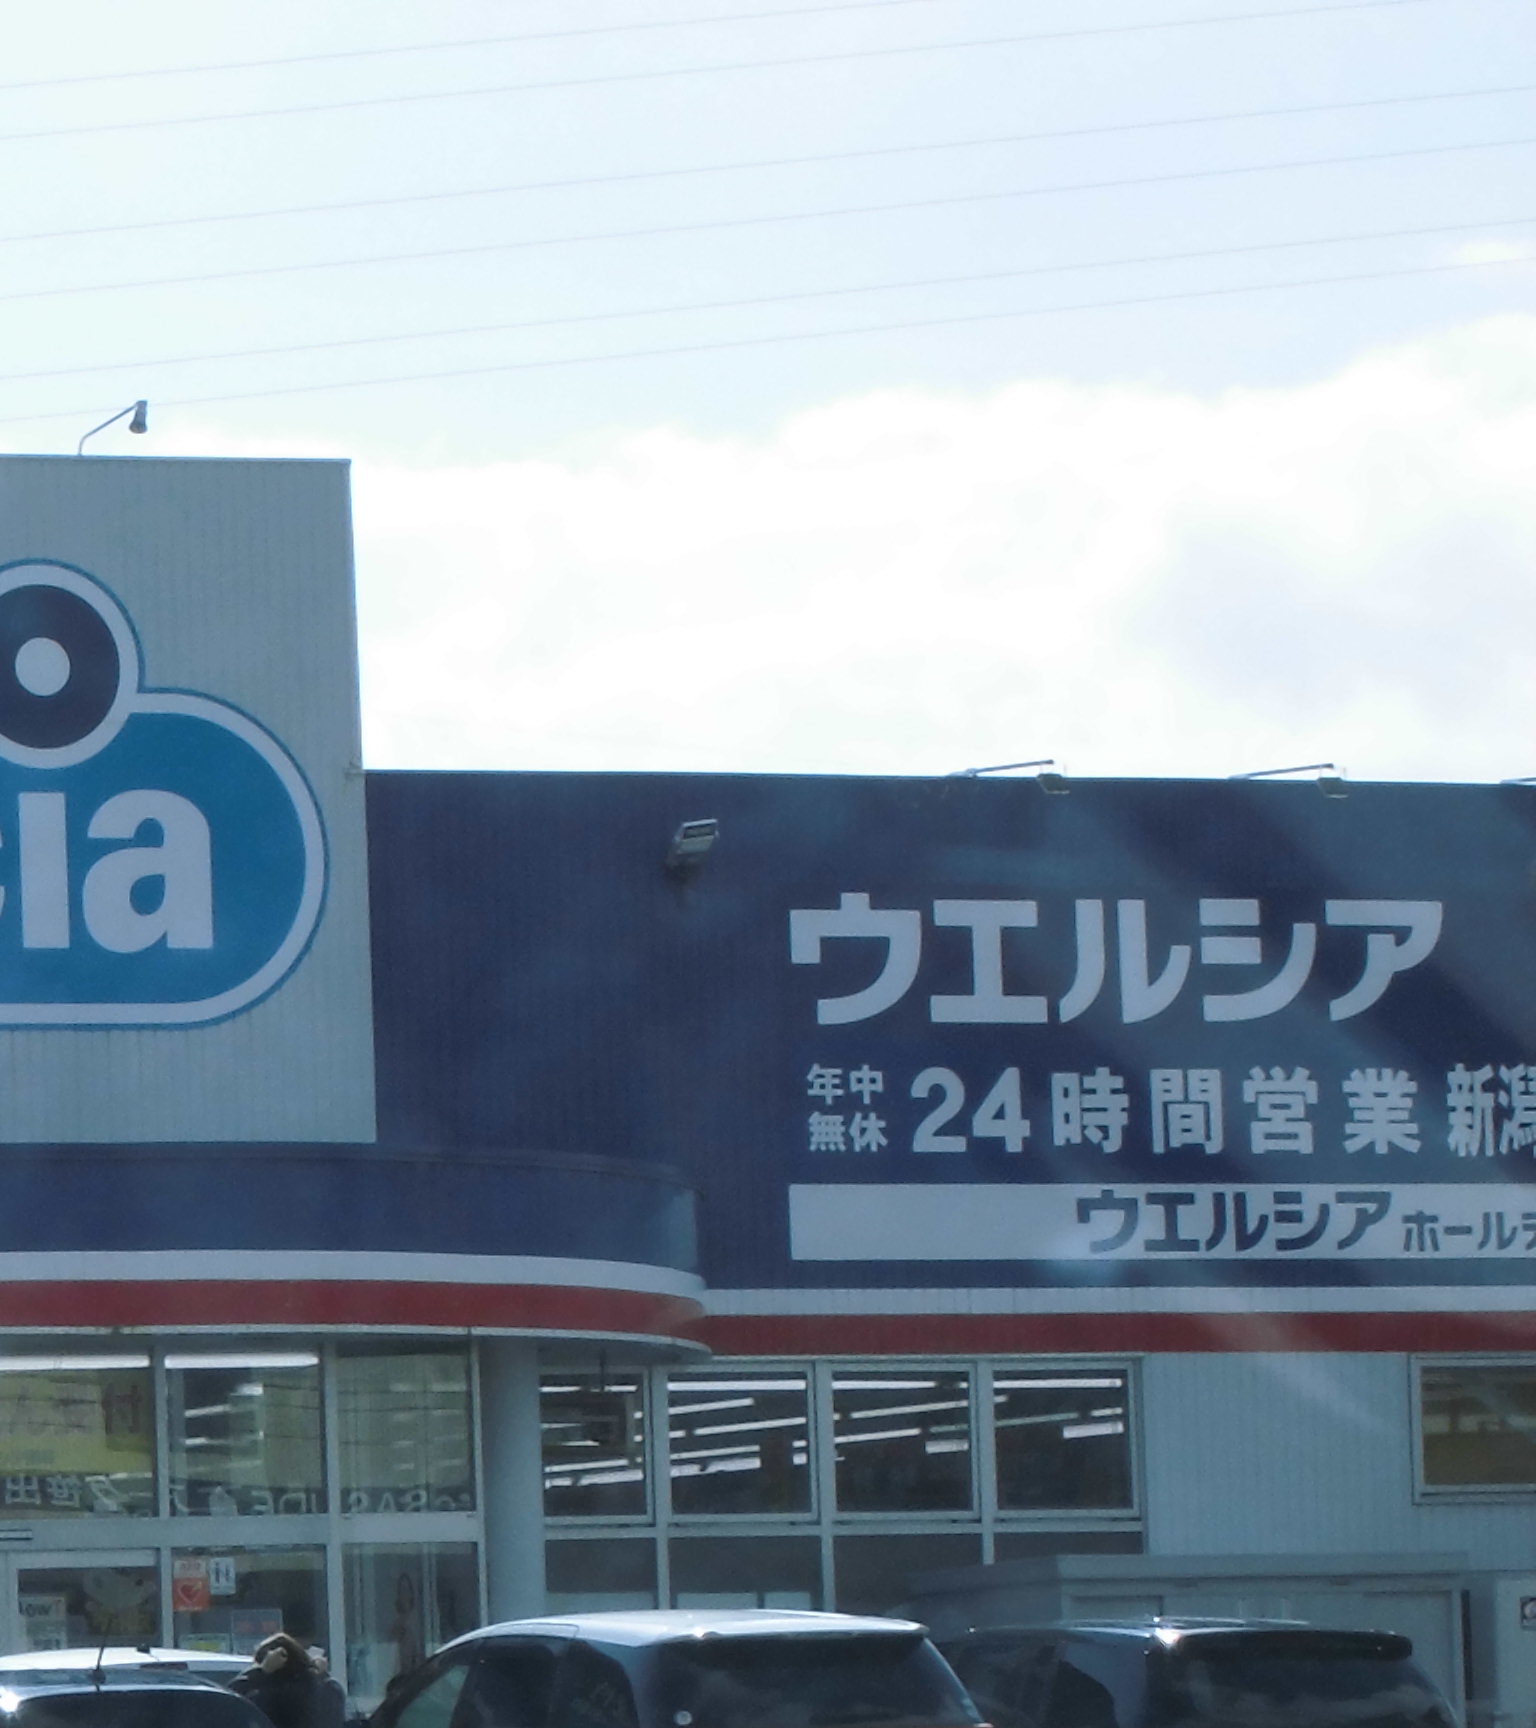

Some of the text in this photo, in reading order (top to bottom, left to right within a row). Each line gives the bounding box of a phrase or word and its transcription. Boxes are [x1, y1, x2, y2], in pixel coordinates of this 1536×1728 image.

[789, 892, 1443, 1025] ウエルシア
[806, 1064, 884, 1106] 年中
[806, 1113, 888, 1152] 無休
[1076, 1188, 1391, 1254] ウエルシア
